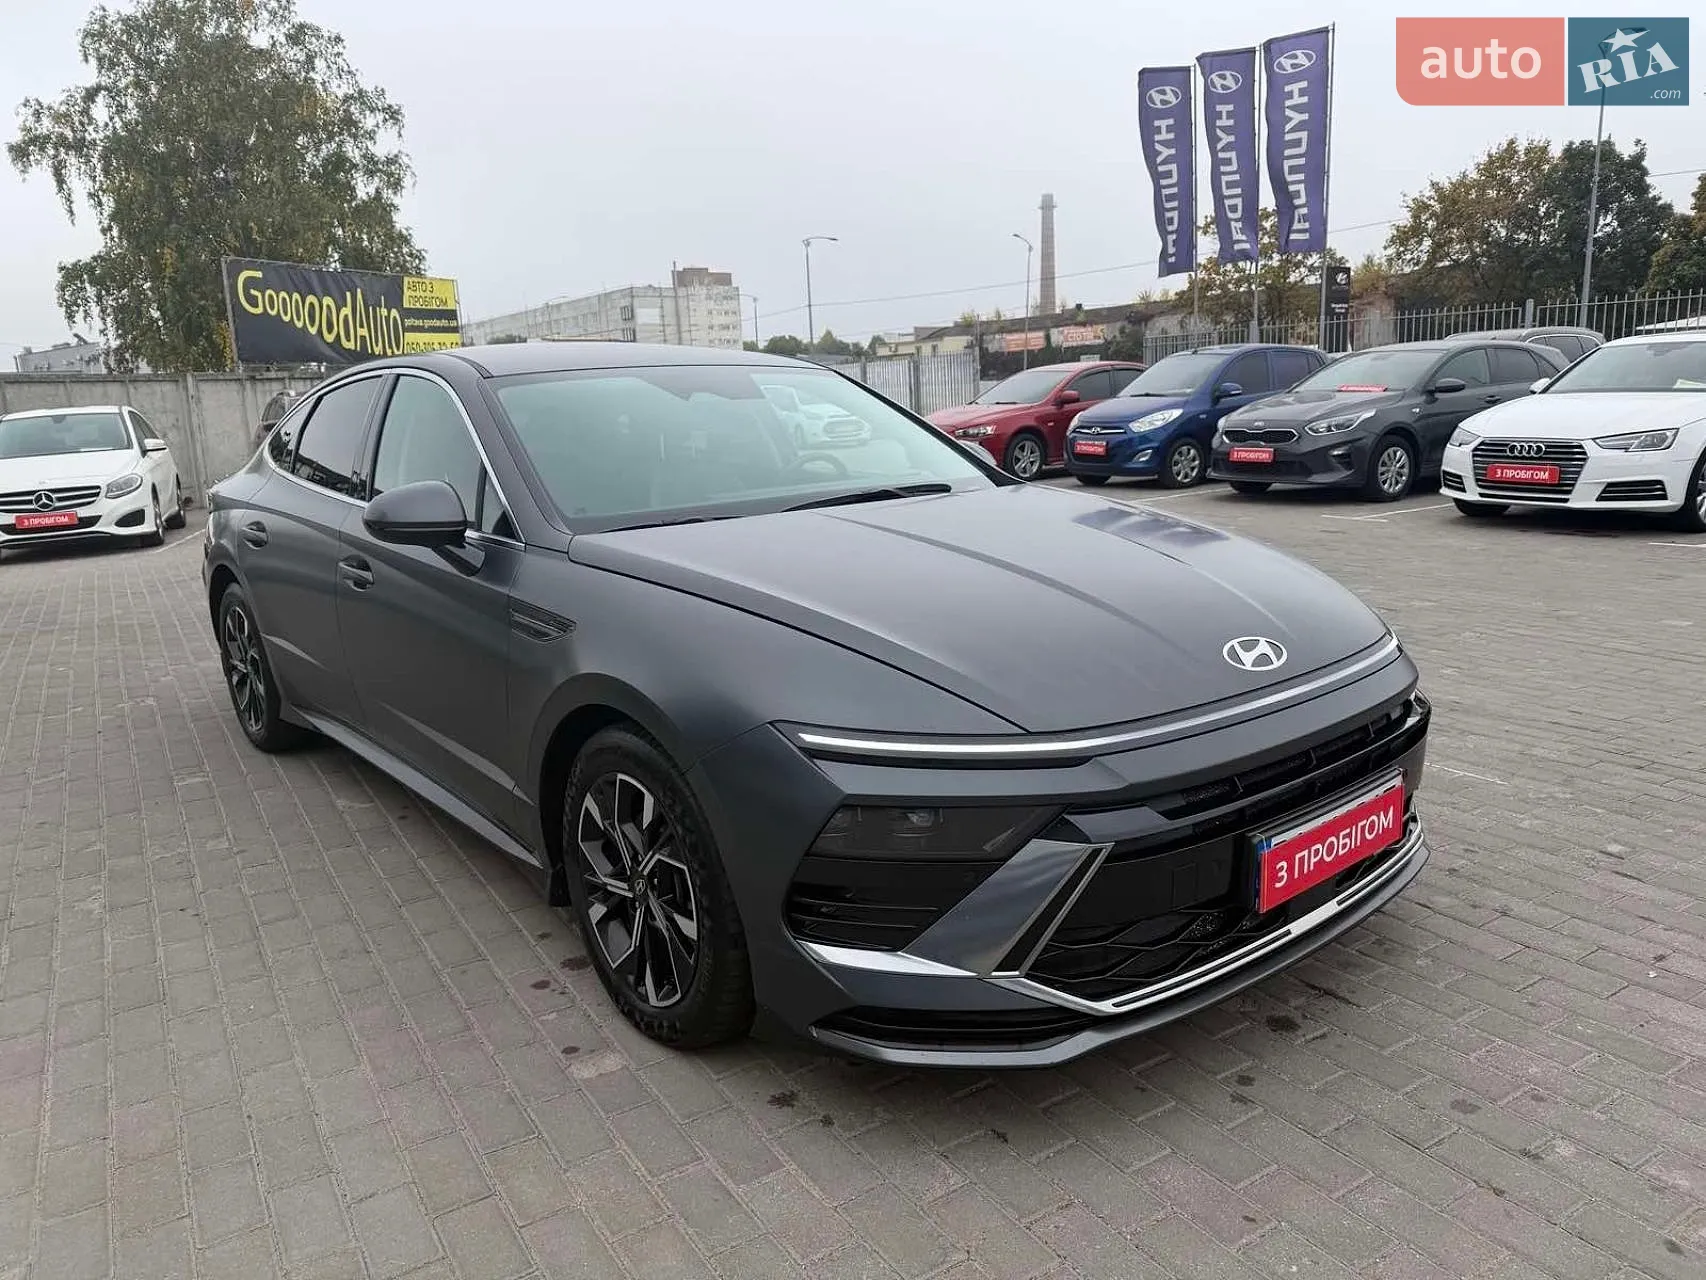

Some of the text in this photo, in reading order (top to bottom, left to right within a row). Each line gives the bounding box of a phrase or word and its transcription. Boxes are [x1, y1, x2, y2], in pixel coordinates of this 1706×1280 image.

[1502, 469, 1549, 480] ПРОБІГОМ
[1274, 805, 1394, 889] З ПРОБІГОМ
